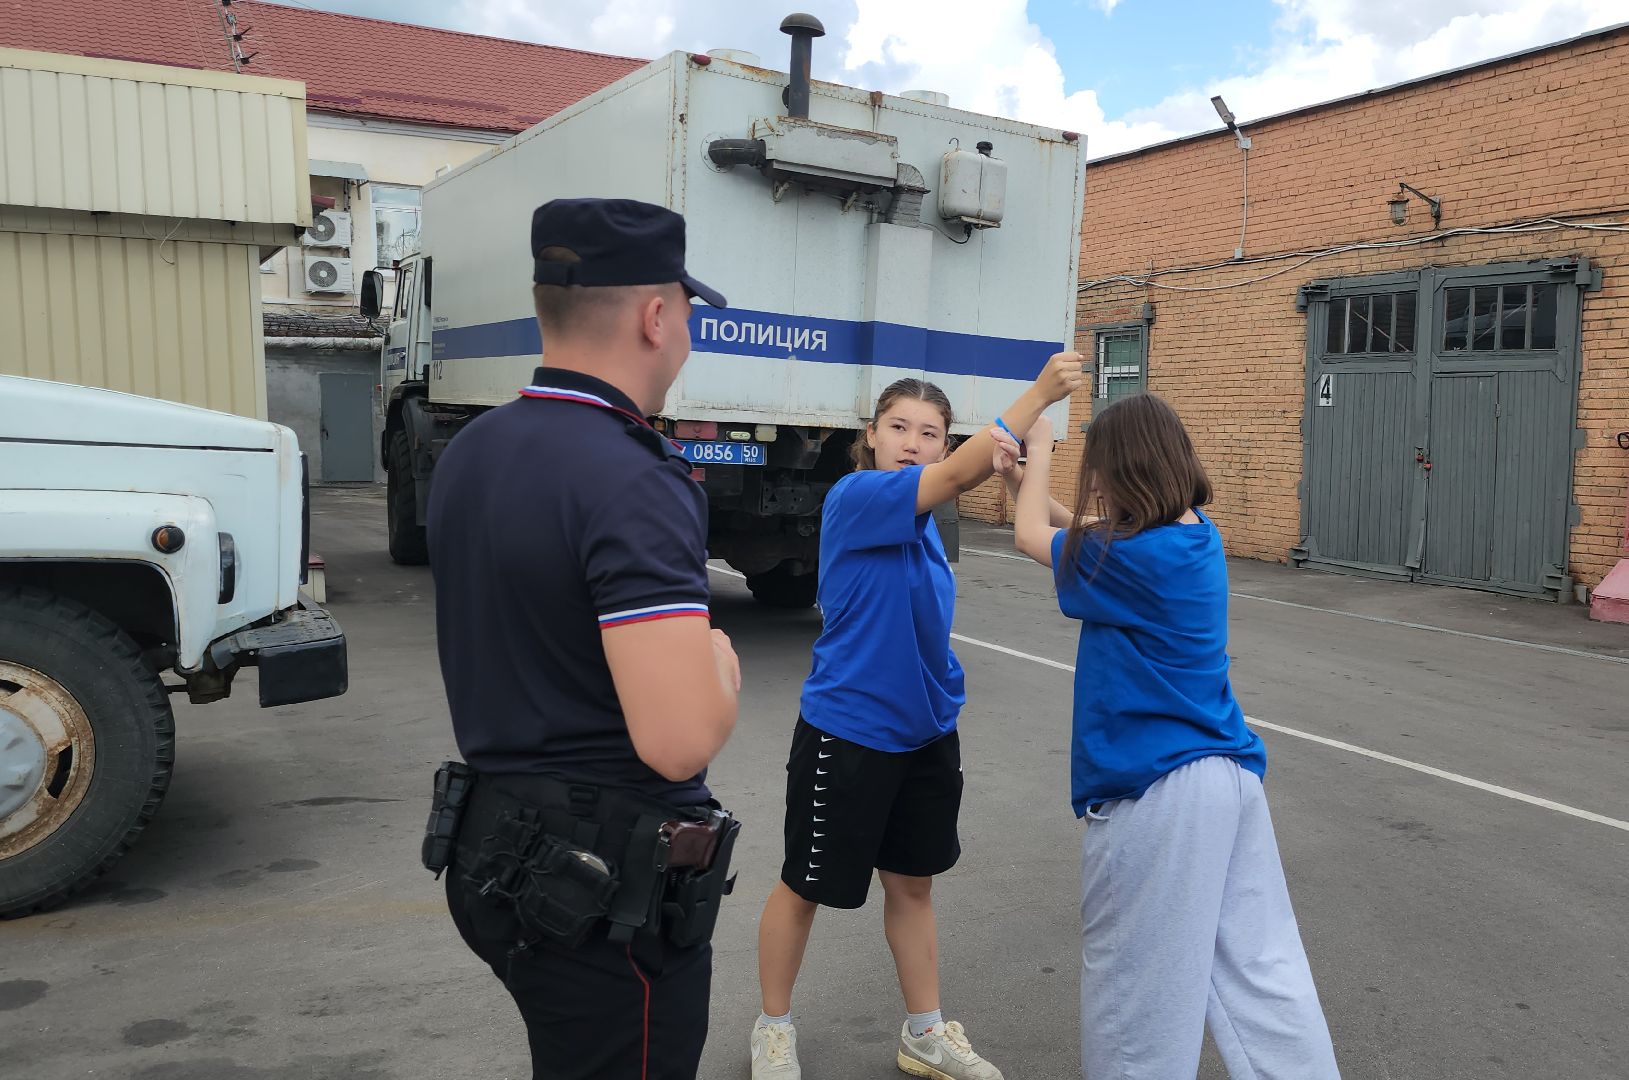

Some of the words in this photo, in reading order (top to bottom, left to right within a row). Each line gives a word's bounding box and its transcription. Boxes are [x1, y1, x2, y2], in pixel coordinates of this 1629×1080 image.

[700, 317, 827, 352] ПОЛИЦИЯ
[1320, 375, 1331, 404] 4
[693, 444, 734, 461] 0856
[743, 445, 758, 458] 50
